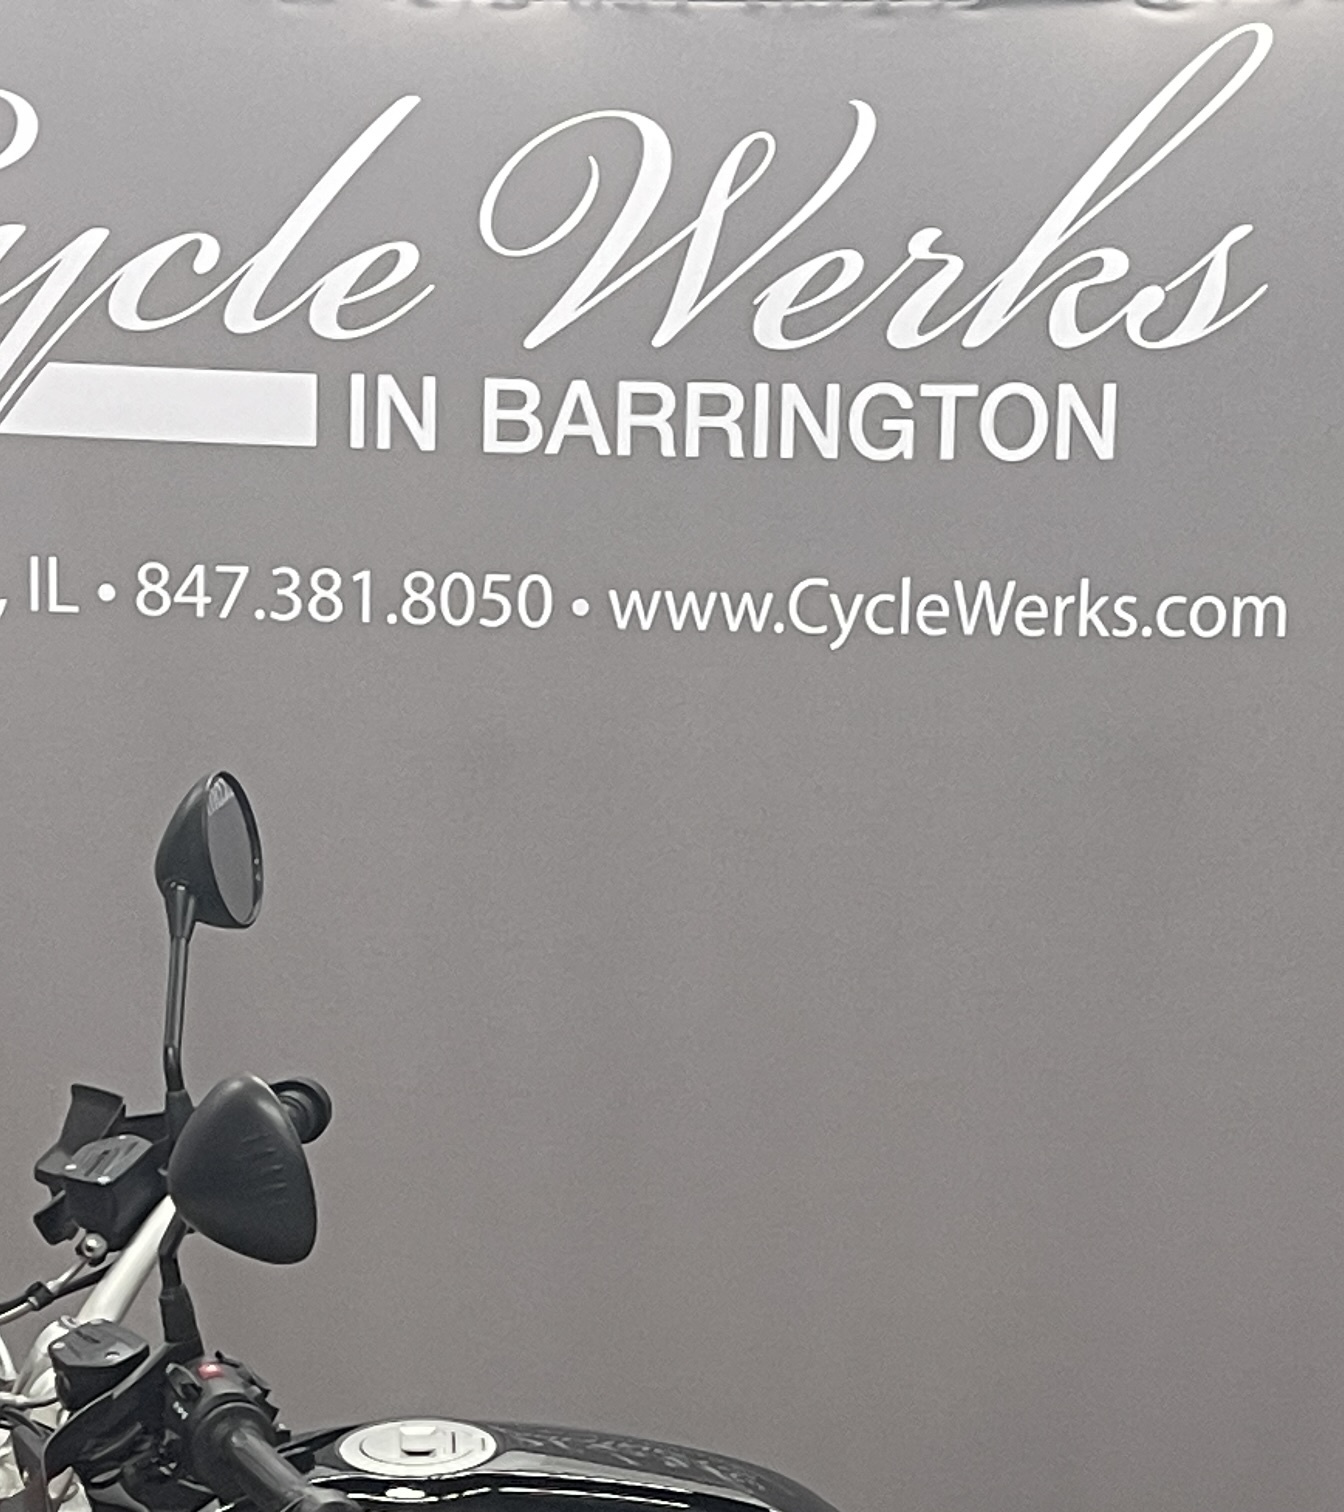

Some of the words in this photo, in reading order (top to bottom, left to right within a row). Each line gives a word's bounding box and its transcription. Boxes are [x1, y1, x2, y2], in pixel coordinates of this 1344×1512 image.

[479, 22, 1274, 350] Werks
[349, 372, 438, 452] IN
[481, 376, 1118, 462] BARRINGTON
[29, 555, 80, 613] IL
[135, 561, 554, 629] 847.381.8050
[608, 576, 1288, 651] www.CycleWerks.com
